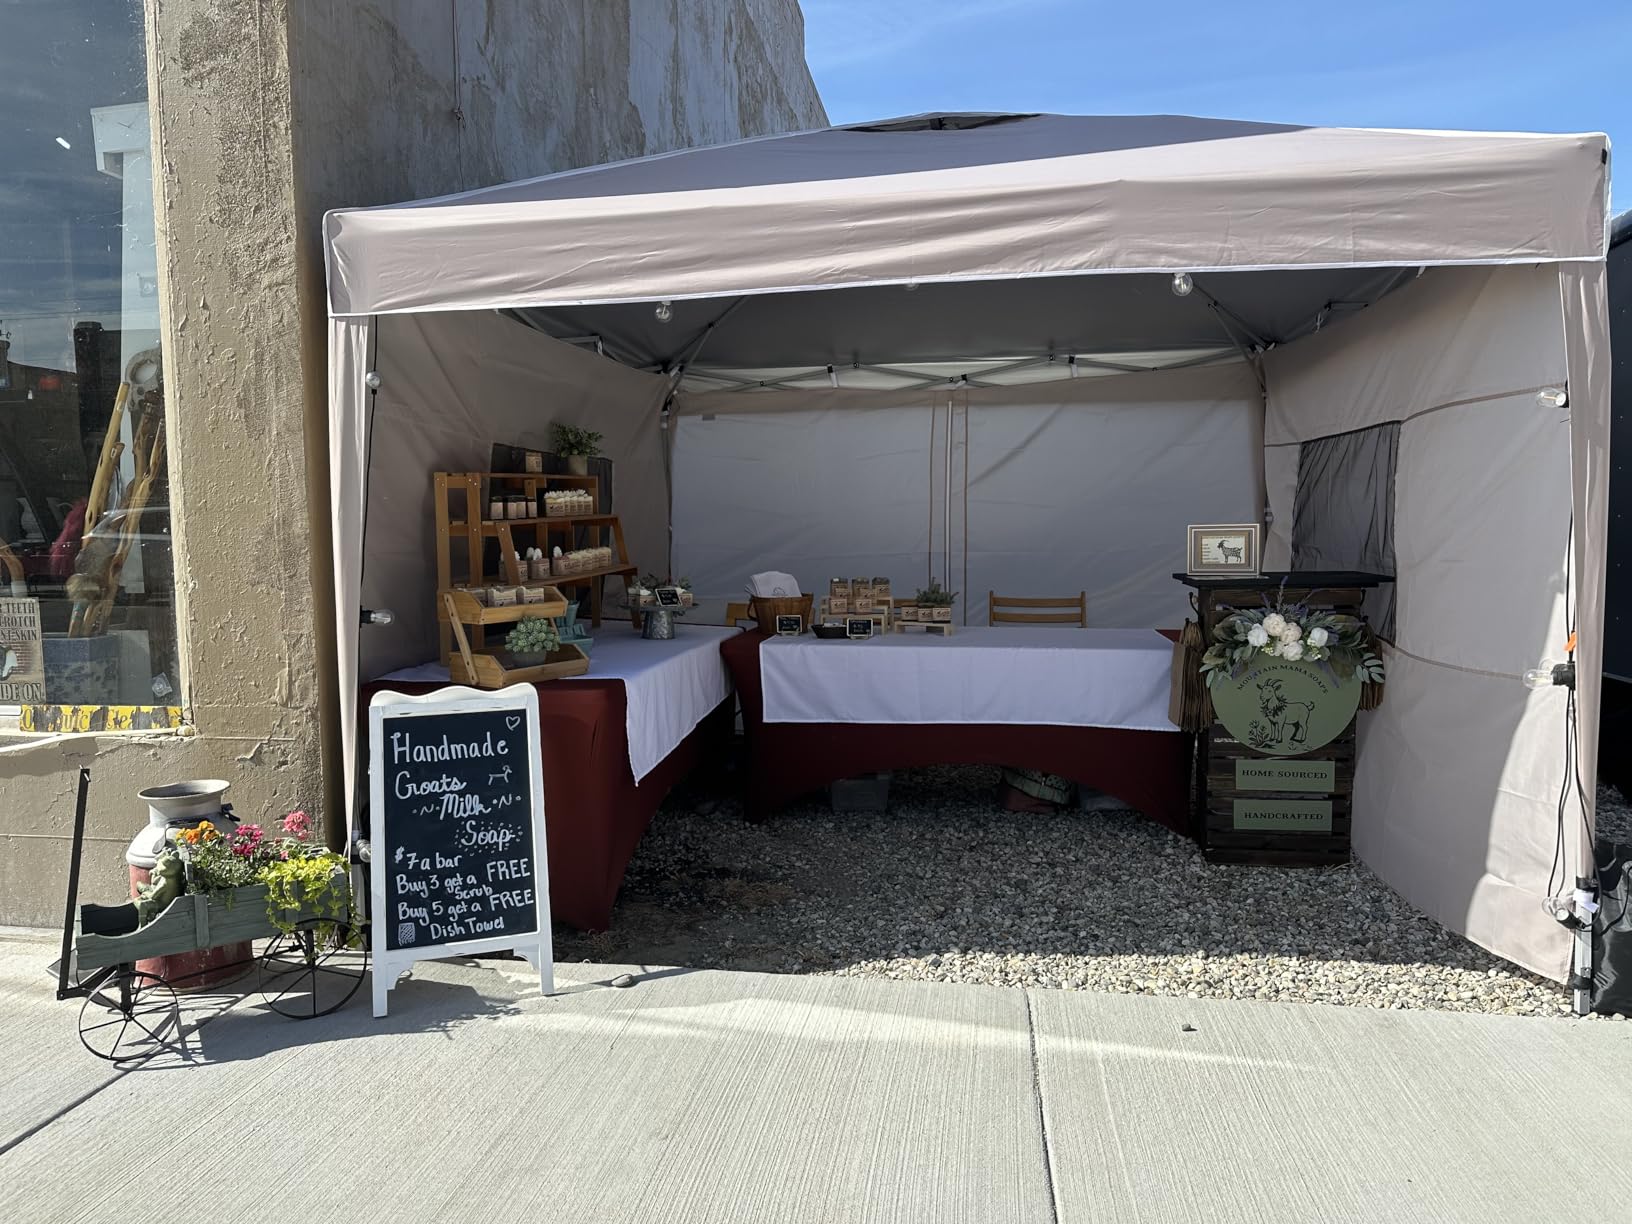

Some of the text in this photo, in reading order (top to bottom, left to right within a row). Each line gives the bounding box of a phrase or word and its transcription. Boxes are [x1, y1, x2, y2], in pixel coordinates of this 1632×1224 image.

[6, 602, 35, 614] TEETH
[15, 629, 38, 641] SKIN
[1280, 664, 1307, 675] MAMA
[1308, 673, 1329, 694] SOAPS
[22, 682, 42, 702] ON
[390, 731, 509, 764] Handmade
[395, 770, 467, 800] Goats
[1241, 769, 1329, 780] HOME SOURCED
[439, 793, 492, 820] Milk
[1243, 812, 1324, 821] HANDCRAFTED
[460, 820, 516, 852] Soap
[420, 857, 431, 871] a
[435, 852, 463, 869] bar
[395, 858, 531, 899] Buy 3 get a FREE
[454, 884, 494, 900] Scrub
[397, 889, 535, 927] Buy 5 get a FREE
[429, 916, 505, 940] Dish Towel
